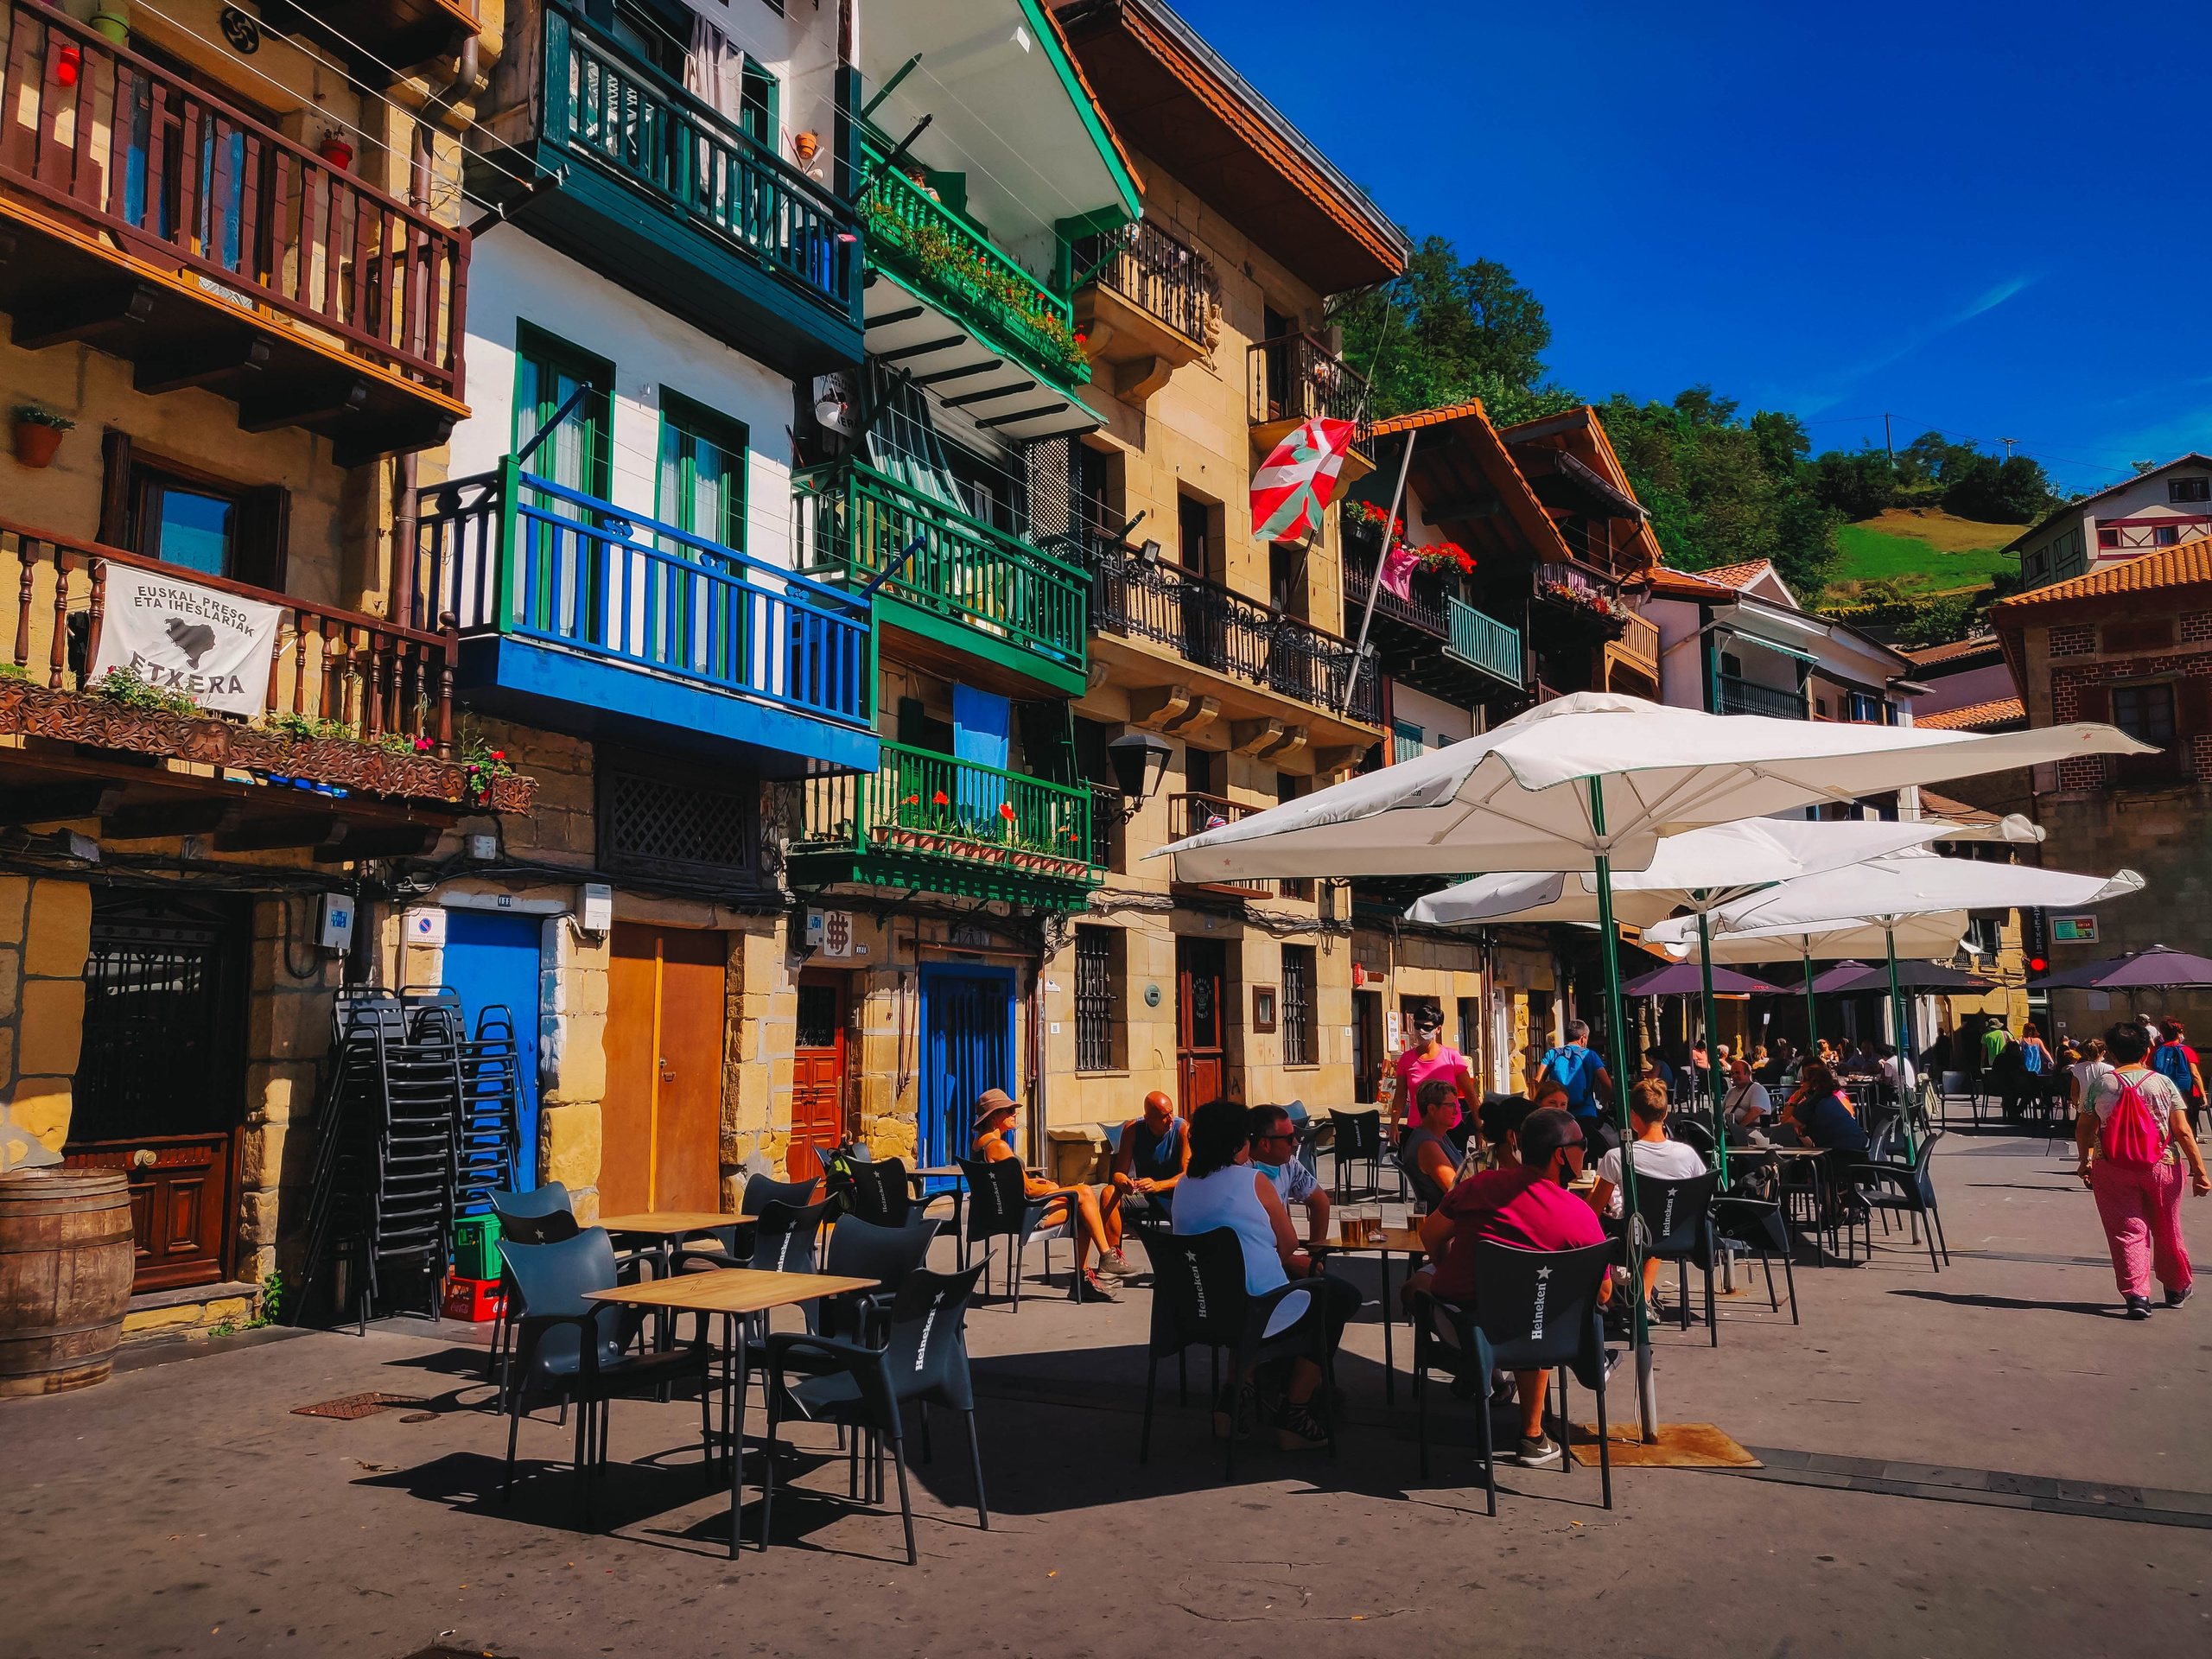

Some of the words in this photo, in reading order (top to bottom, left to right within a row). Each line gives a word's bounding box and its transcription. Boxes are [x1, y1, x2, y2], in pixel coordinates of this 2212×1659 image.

[134, 596, 163, 608] ETA
[168, 600, 255, 638] IHESLARIAK
[137, 586, 196, 603] EUSKAL
[202, 596, 247, 623] PRESO
[130, 650, 245, 694] ETXERA
[1662, 1198, 1675, 1236] Heineken
[776, 1232, 792, 1273] eineken
[1192, 1265, 1207, 1319] Heineken
[1531, 1283, 1548, 1340] Heineken
[915, 1307, 938, 1371] Heineken
